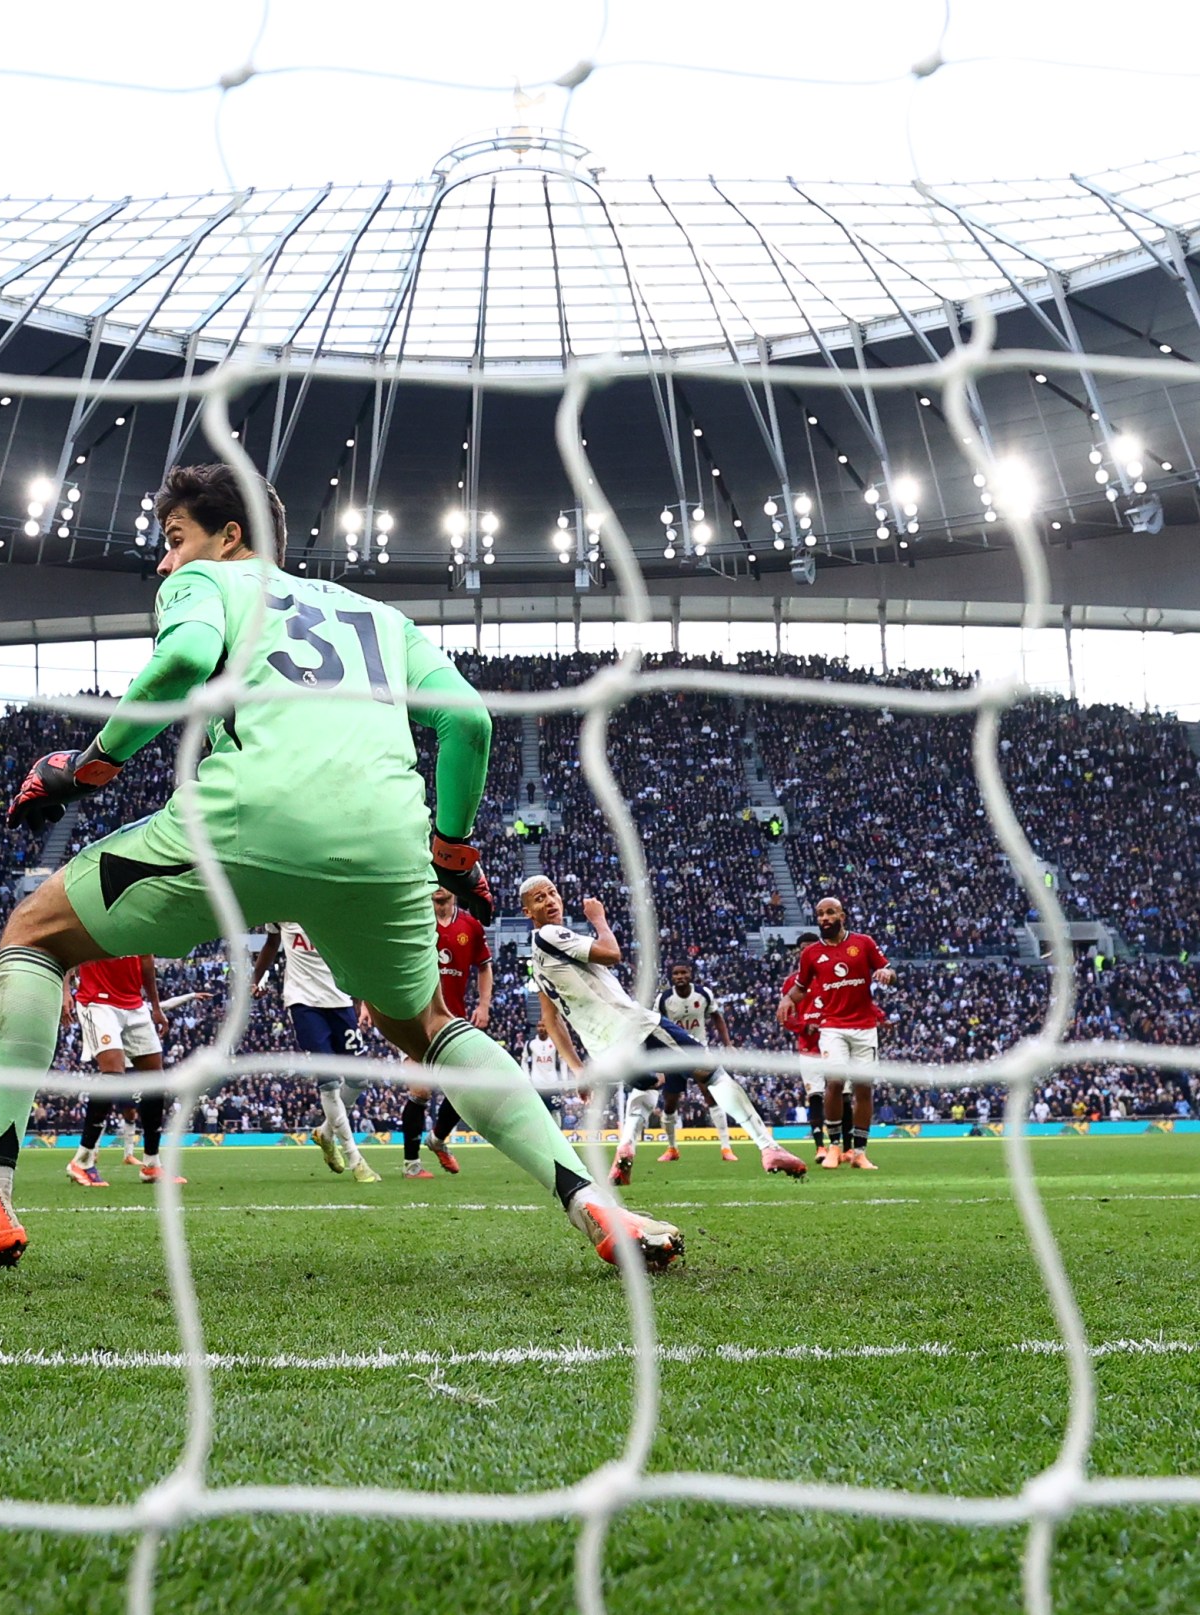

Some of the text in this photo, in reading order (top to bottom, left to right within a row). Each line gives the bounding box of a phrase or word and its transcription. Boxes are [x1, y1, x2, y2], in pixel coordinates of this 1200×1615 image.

[266, 592, 395, 705] 31
[822, 978, 866, 992] Snapdragon
[536, 1055, 554, 1064] AIA
